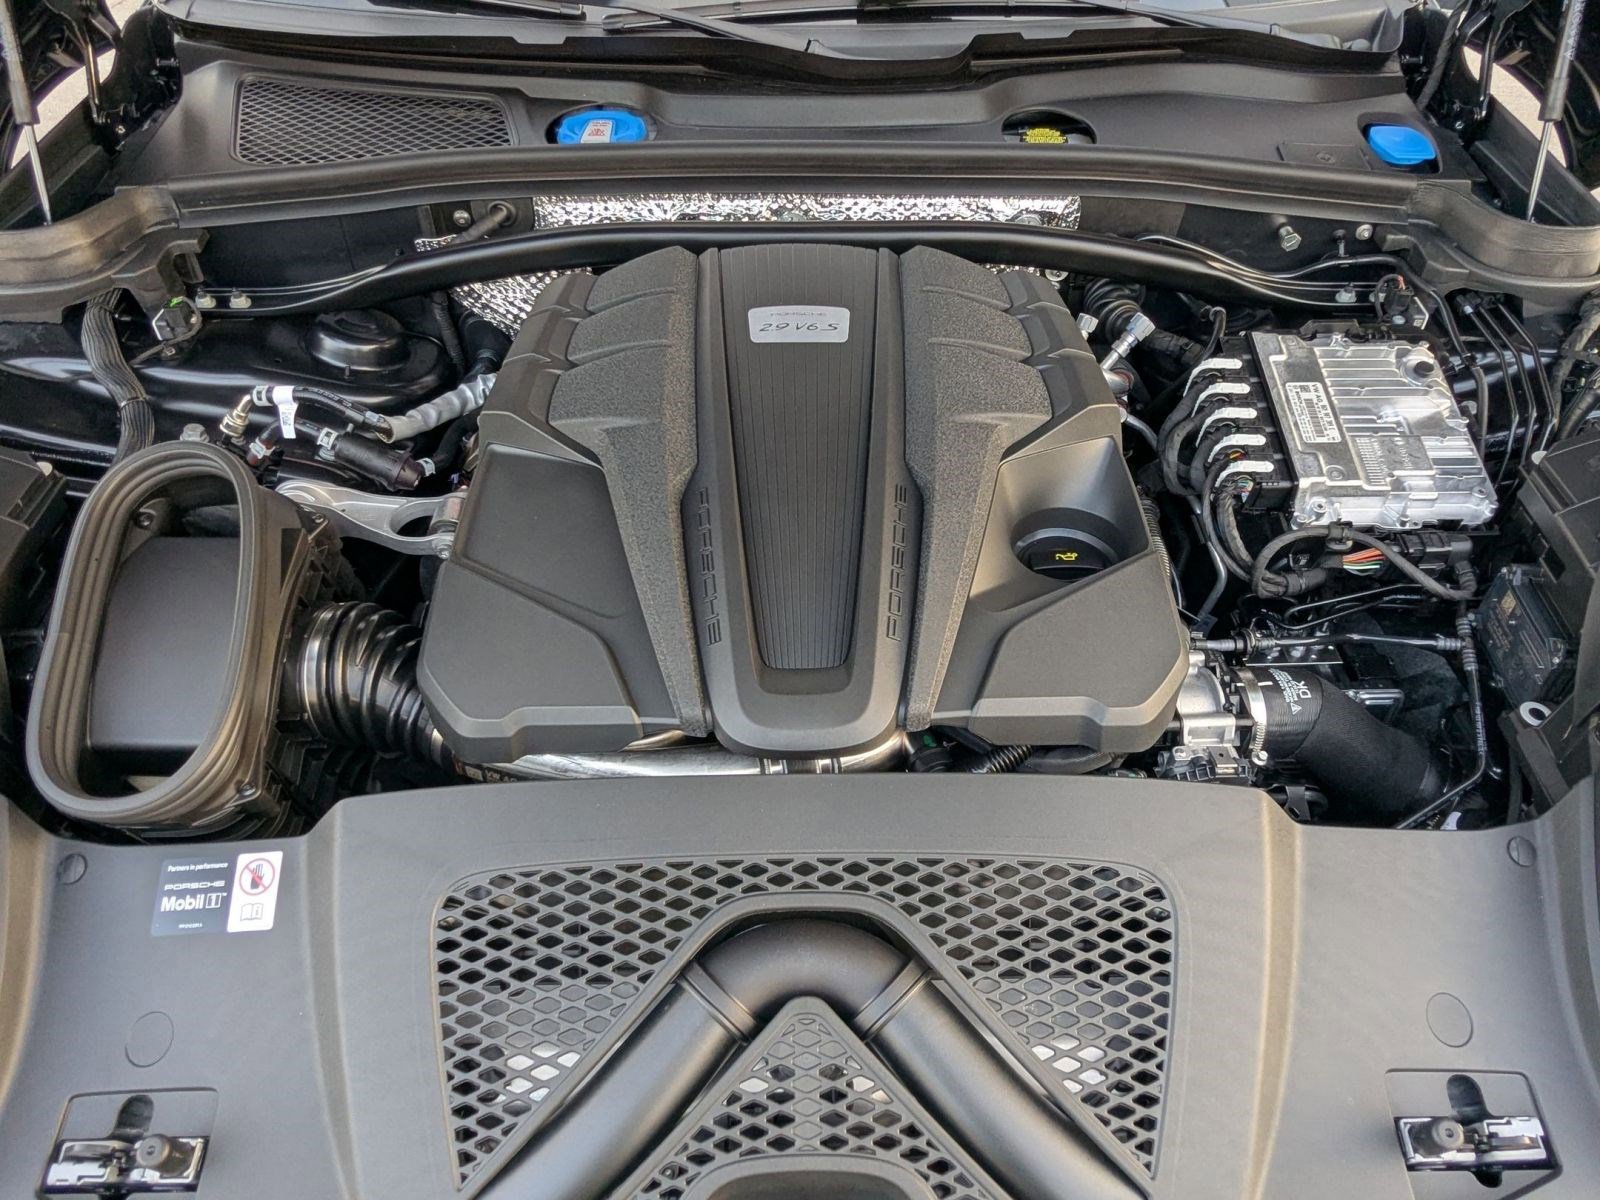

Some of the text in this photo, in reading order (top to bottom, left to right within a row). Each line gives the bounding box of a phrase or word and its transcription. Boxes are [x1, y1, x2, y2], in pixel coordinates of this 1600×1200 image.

[759, 322, 841, 332] 2.9 V6 S
[697, 488, 722, 646] PORSCHE
[885, 483, 908, 642] PORSCHE
[167, 864, 189, 872] Partners
[195, 862, 229, 872] performance
[164, 880, 226, 891] PORSCHE
[160, 894, 205, 912] Mobil
